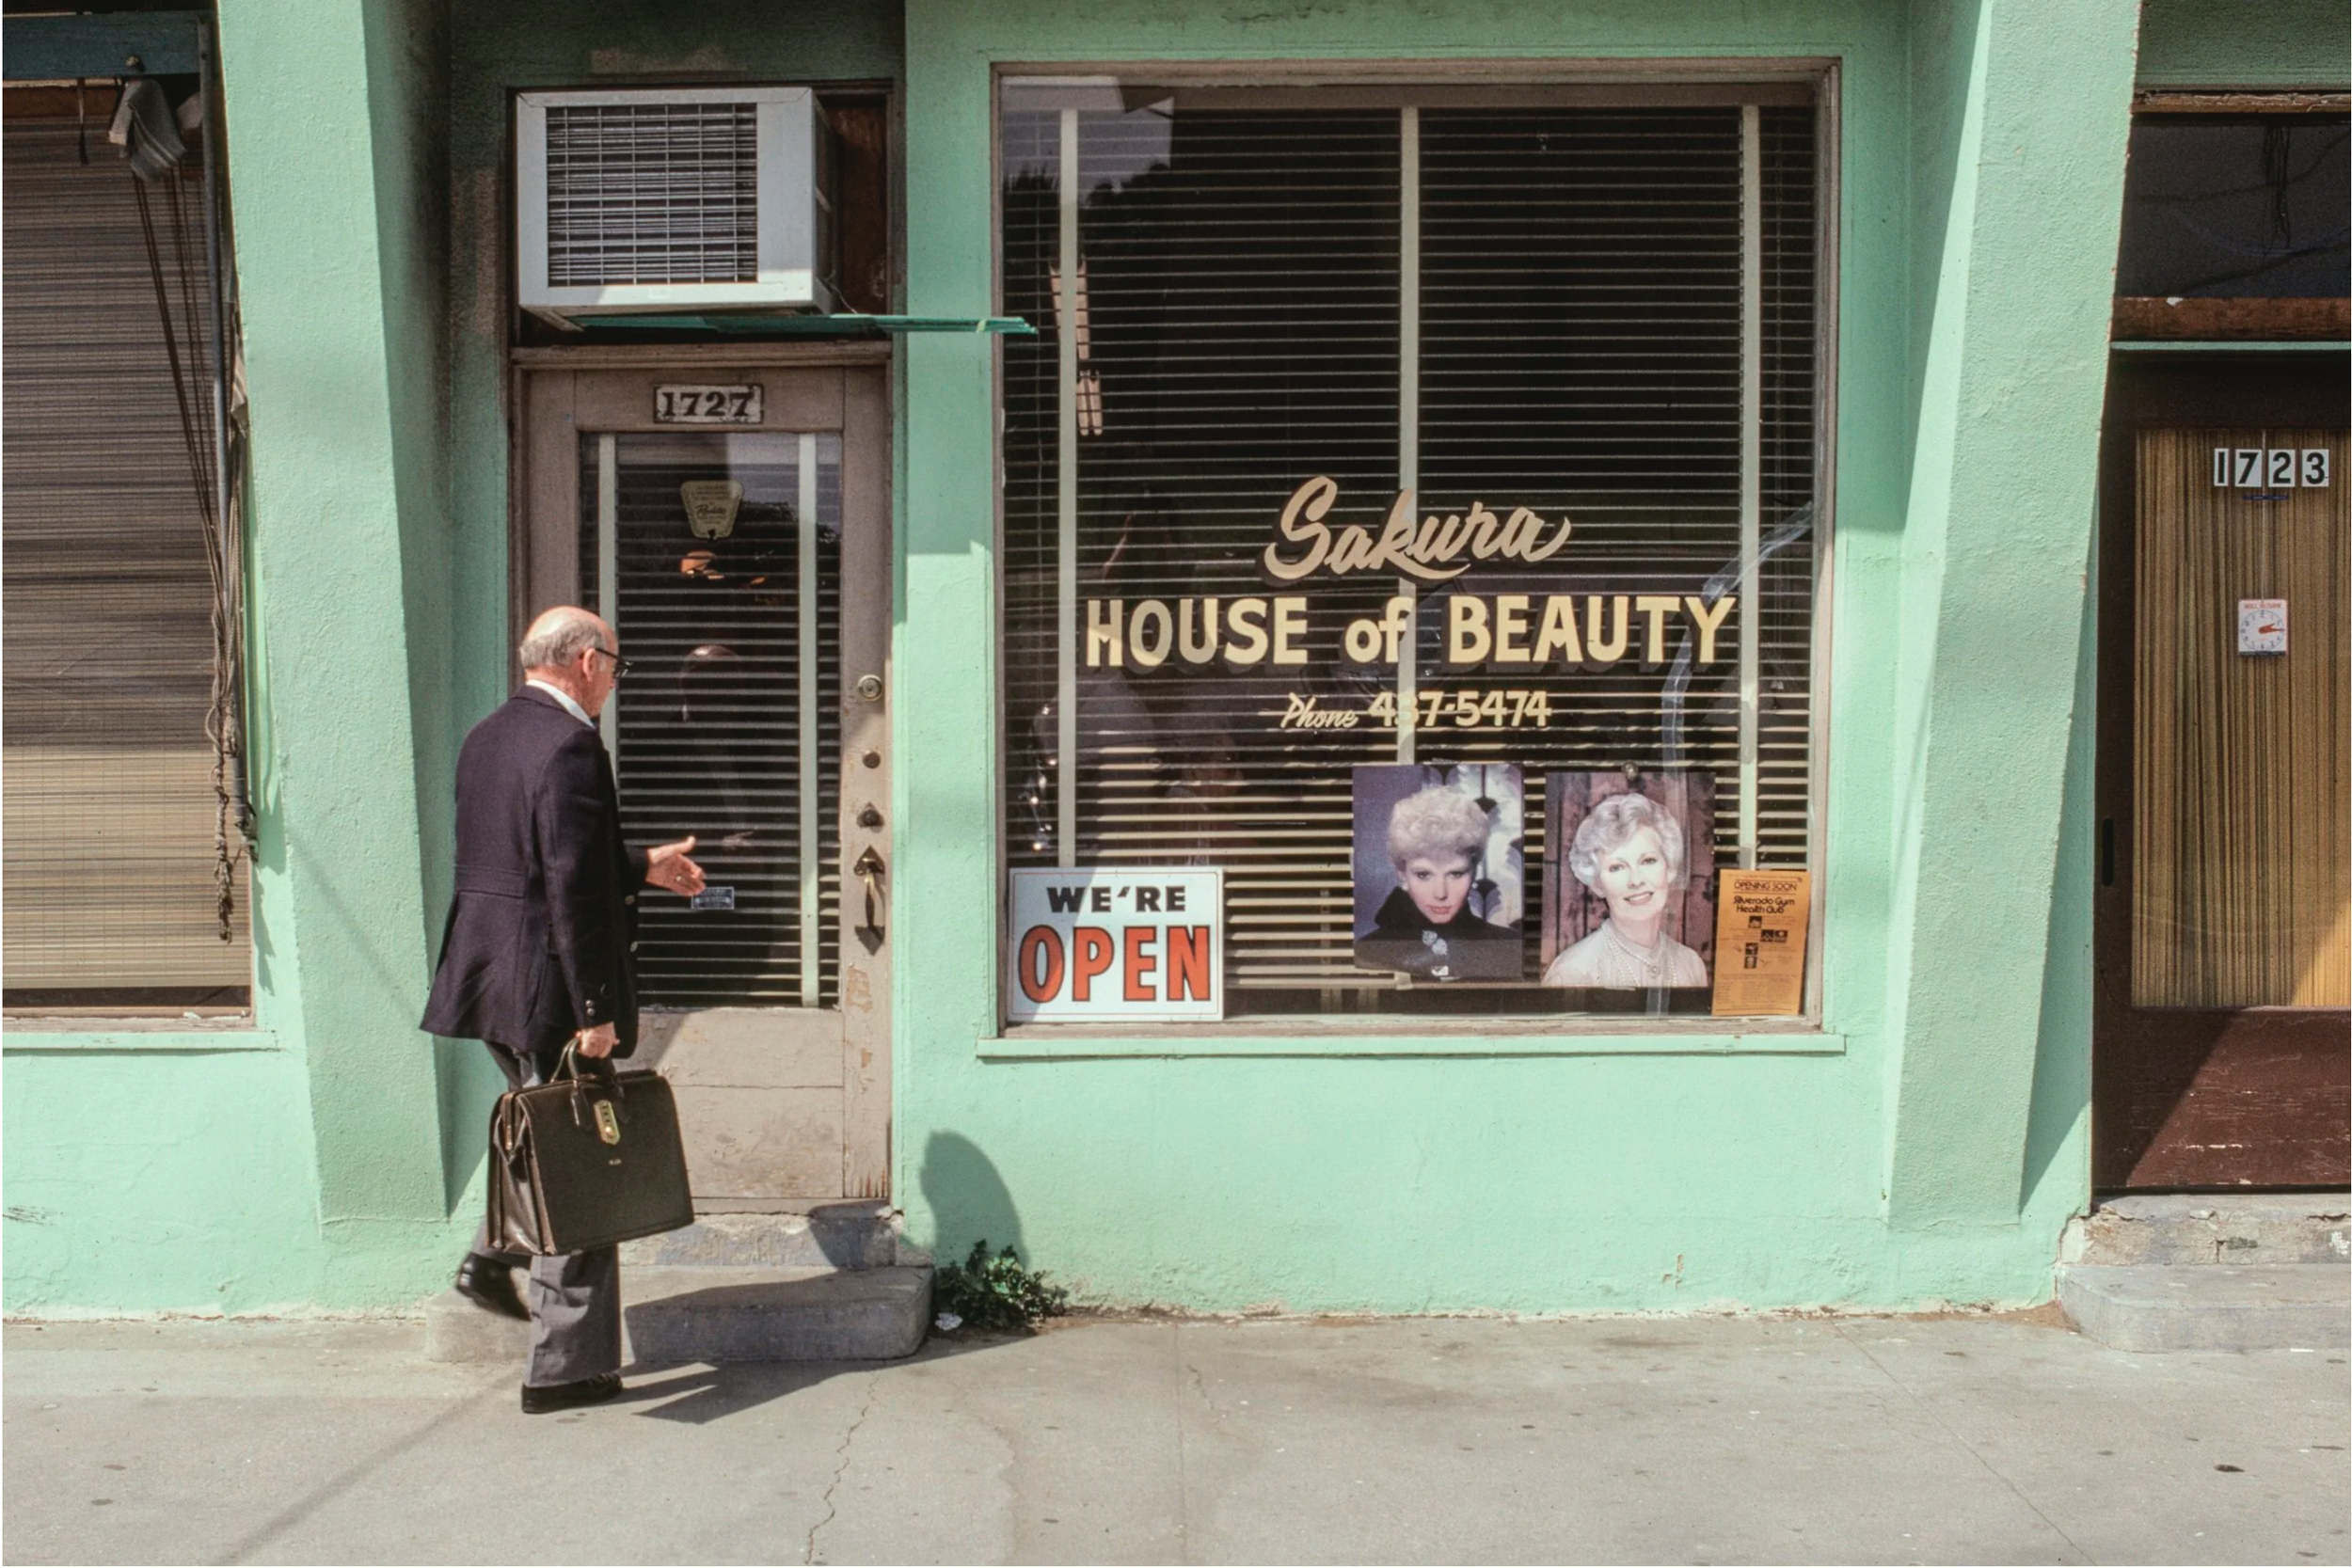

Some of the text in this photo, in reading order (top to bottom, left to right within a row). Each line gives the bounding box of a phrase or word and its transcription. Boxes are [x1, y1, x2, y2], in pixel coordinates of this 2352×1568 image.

[661, 391, 755, 417] 1727
[2217, 451, 2326, 484] 1723
[1263, 475, 1572, 580] Sakura
[1086, 594, 1737, 667] HOUSE of BEAUTY
[1279, 691, 1359, 729] Phone
[1046, 885, 1186, 913] WE'RE
[1734, 881, 1797, 893] OPENING SOON
[1736, 904, 1765, 913] Health
[1774, 896, 1795, 909] Gym
[1017, 924, 1212, 1004] OPEN
